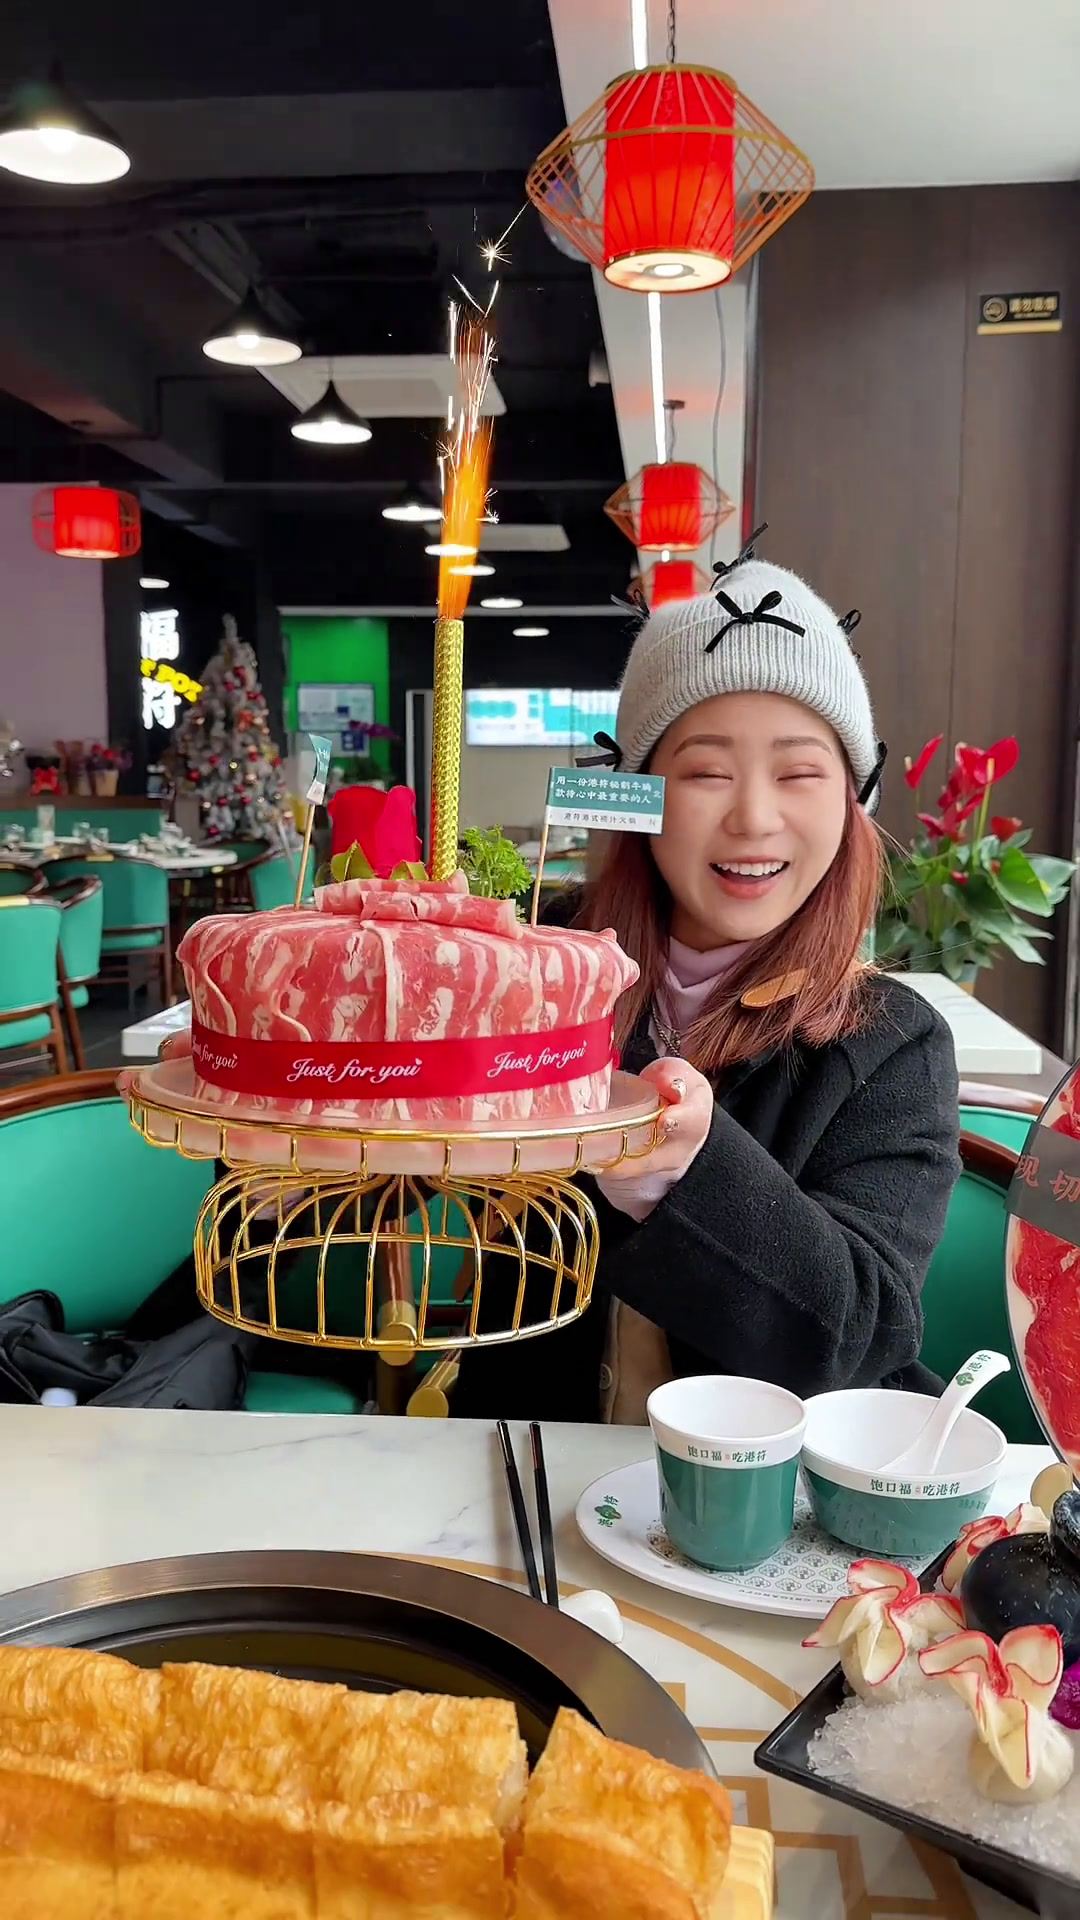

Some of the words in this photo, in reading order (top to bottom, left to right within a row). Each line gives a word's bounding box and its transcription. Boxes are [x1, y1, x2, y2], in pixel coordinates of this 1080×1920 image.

[555, 787, 652, 805] 款待心中最重要的人
[200, 1043, 215, 1063] for
[212, 1054, 238, 1070] you
[486, 1051, 533, 1078] Just
[526, 1047, 561, 1074] for
[556, 1044, 586, 1069] you
[286, 1057, 336, 1082] Just
[327, 1058, 375, 1083] for
[369, 1060, 421, 1084] you
[687, 1445, 722, 1461] 饱口福
[732, 1449, 767, 1463] 吃港符
[870, 1478, 912, 1495] 饱口福
[922, 1481, 961, 1497] 吃港符
